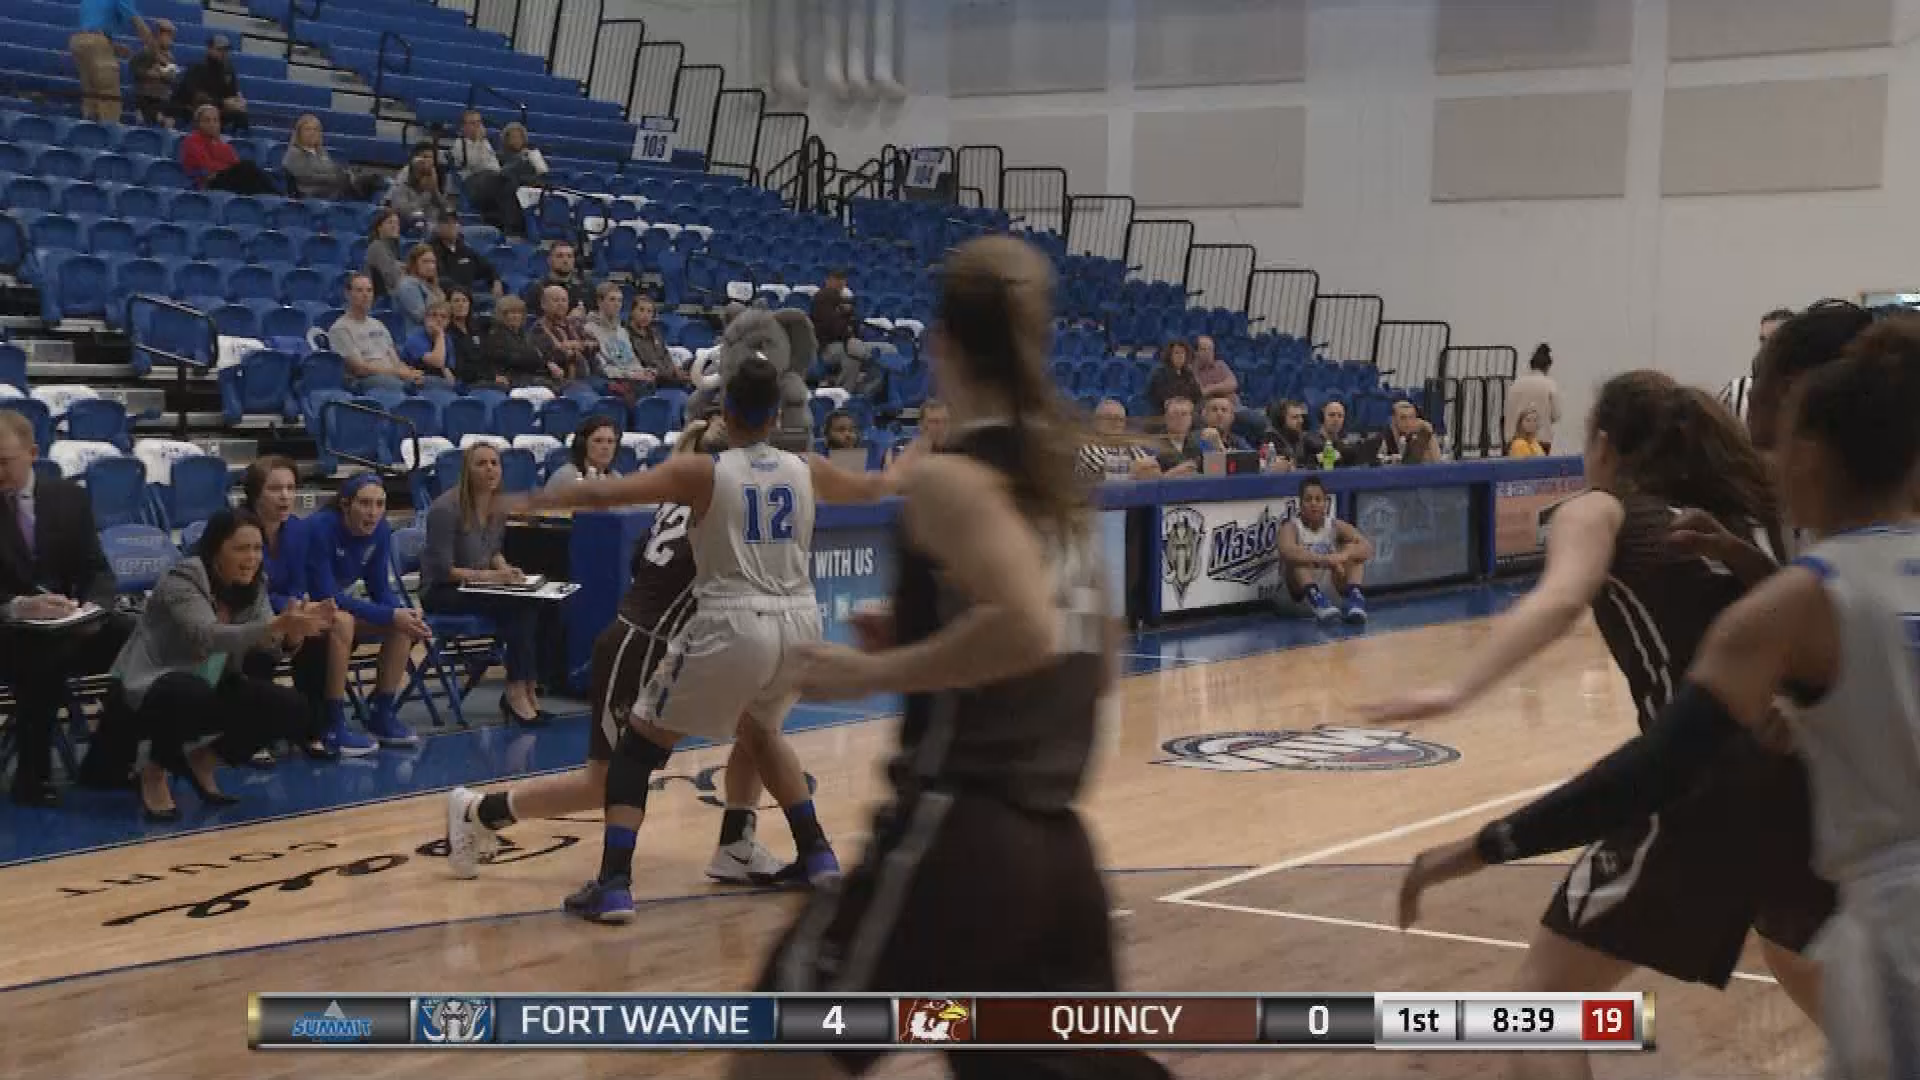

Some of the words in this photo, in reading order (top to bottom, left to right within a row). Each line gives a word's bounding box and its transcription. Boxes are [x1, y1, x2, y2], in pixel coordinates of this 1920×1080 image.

[643, 135, 668, 158] 103
[743, 484, 798, 545] 12
[815, 549, 851, 578] WITH
[854, 547, 873, 576] US
[56, 841, 338, 898] COURT
